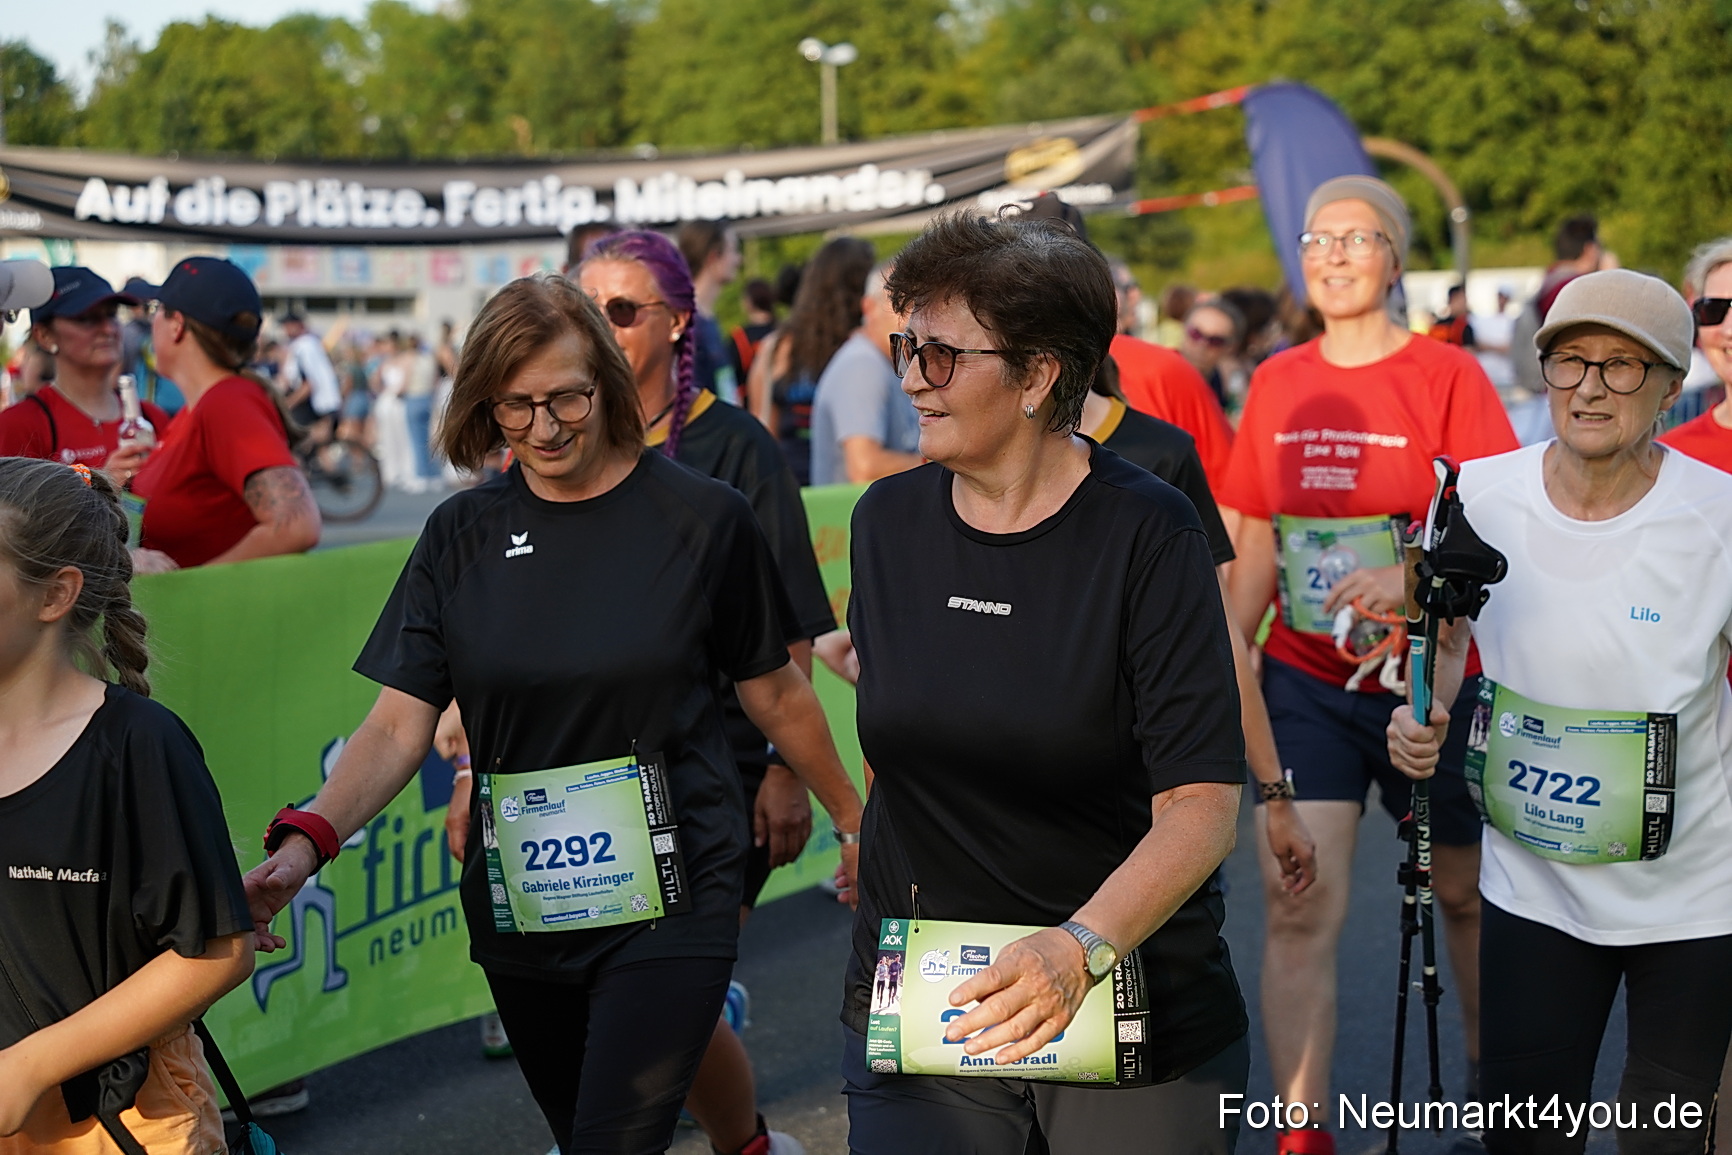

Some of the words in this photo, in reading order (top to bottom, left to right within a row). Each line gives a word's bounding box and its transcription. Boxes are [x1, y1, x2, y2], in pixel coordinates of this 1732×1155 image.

[75, 175, 170, 224] Auf
[173, 174, 261, 228] die
[263, 178, 441, 228] Plätze.
[443, 174, 611, 235] Fertig.
[505, 545, 534, 558] erima
[947, 596, 1012, 616] STANNO
[1630, 606, 1661, 623] Lilo
[639, 764, 652, 803] RABATT
[648, 764, 658, 792] OUTLET
[1508, 759, 1601, 807] 2722
[521, 799, 566, 816] Firmenlauf
[648, 812, 656, 826] 20
[653, 793, 664, 825] FACTORY
[1524, 802, 1546, 819] Lilo
[1549, 809, 1584, 828] Lang
[1647, 816, 1661, 854] HILTL
[521, 831, 616, 871] 2292
[8, 866, 54, 880] Nathalie
[522, 879, 571, 893] Gabriele
[572, 871, 635, 889] Kirzinger
[661, 857, 678, 904] HILTL
[882, 935, 903, 946] AOK
[1115, 982, 1123, 991] %
[1126, 969, 1134, 1008] FACTORY
[1116, 993, 1124, 1009] 20
[960, 1055, 999, 1067] Ann
[1123, 1047, 1135, 1079] HILTL
